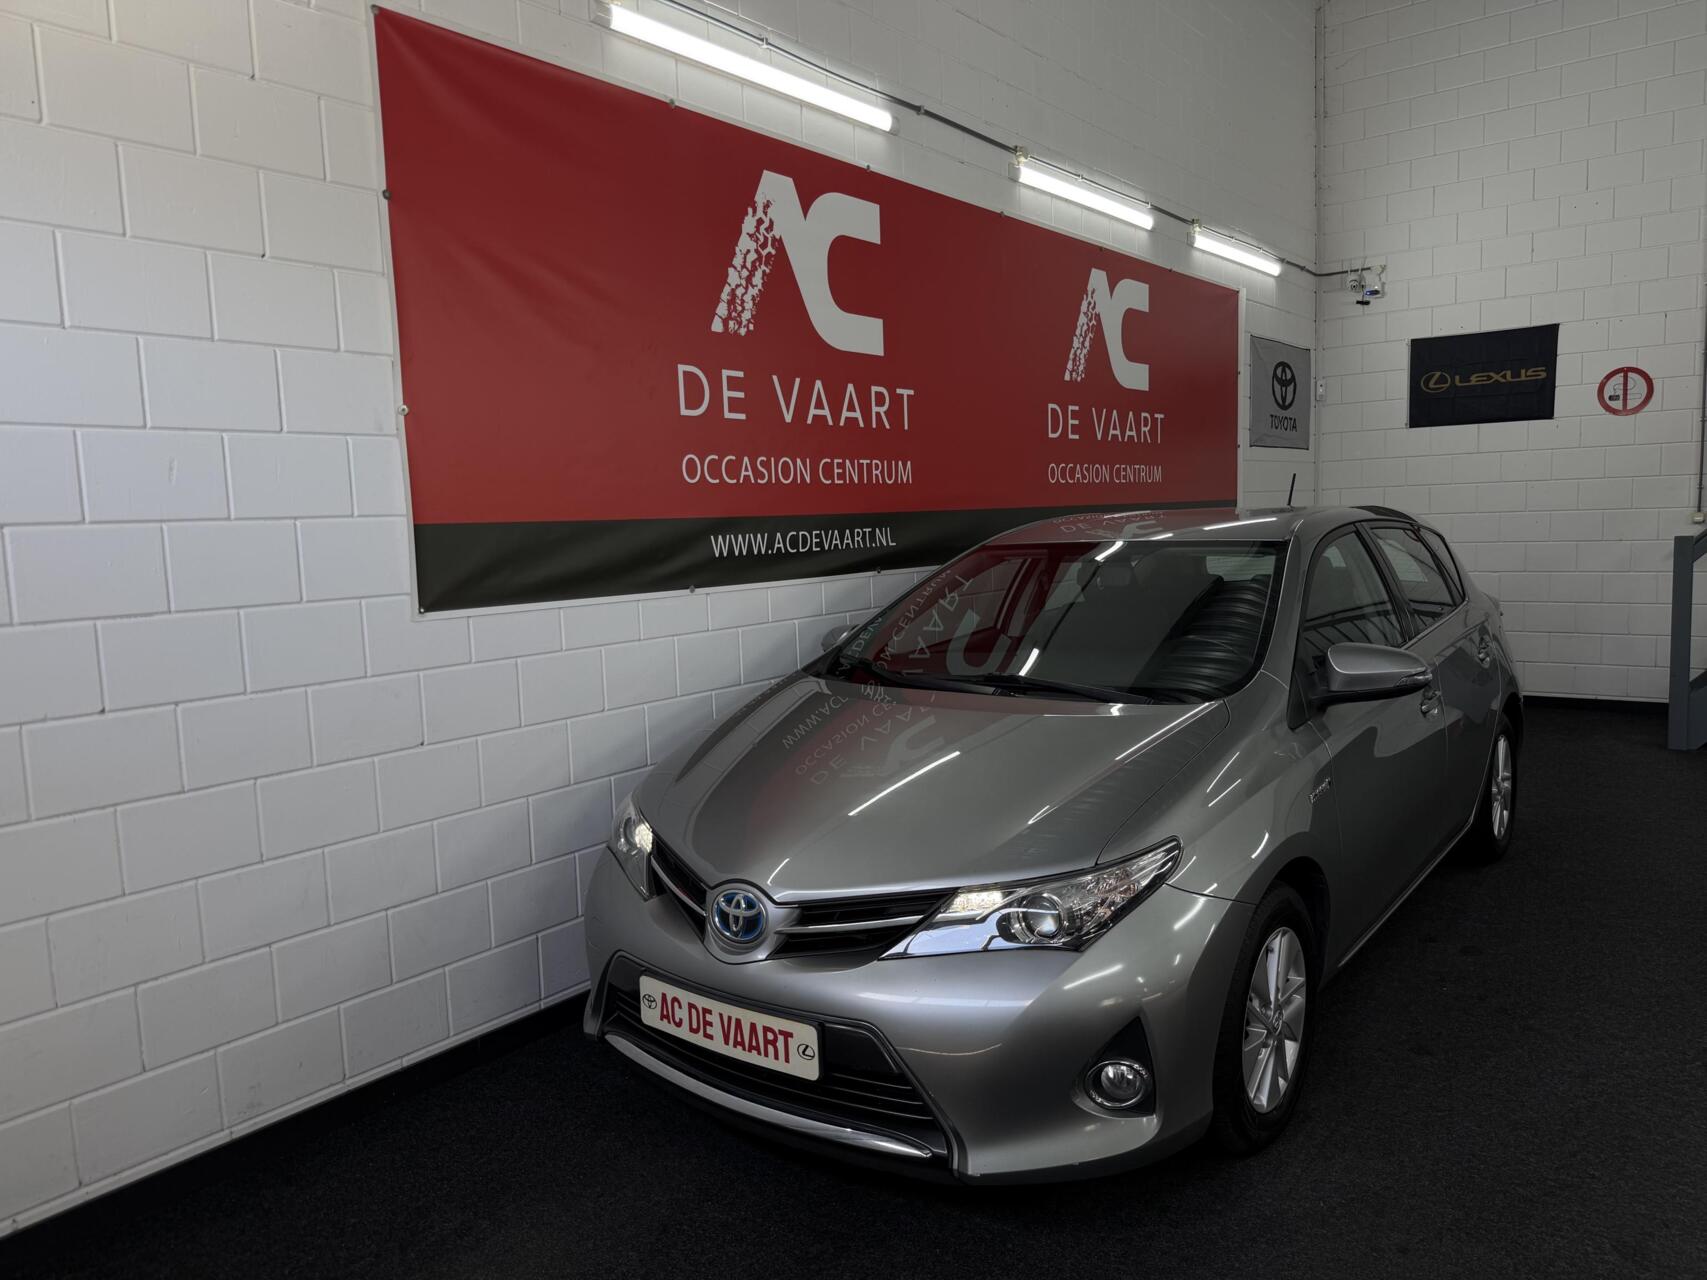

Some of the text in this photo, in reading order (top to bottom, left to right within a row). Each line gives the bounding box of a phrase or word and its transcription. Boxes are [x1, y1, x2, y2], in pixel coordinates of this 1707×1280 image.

[1455, 367, 1547, 386] LEXUS
[677, 364, 915, 430] DE VAART
[1047, 403, 1165, 444] DE VAART
[1270, 414, 1298, 432] TOYOTA
[681, 454, 913, 485] OCCASION CENTRUM
[1048, 463, 1162, 484] OCCASION CENTRUM
[711, 527, 897, 558] WWW.ACDEVAART.NL
[660, 992, 683, 1028] AC
[687, 1001, 714, 1041] DE
[719, 1012, 793, 1063] VAART
